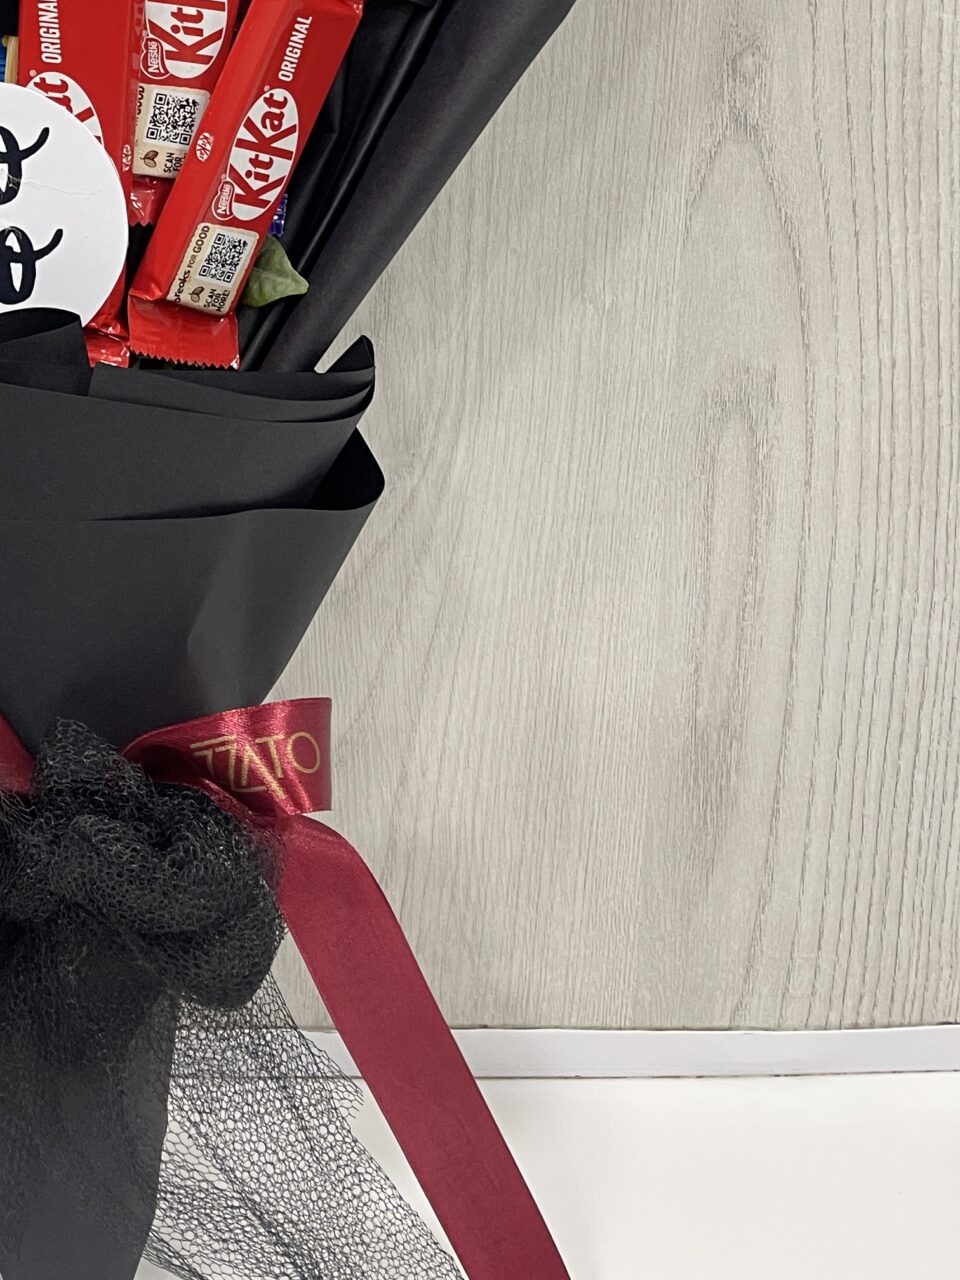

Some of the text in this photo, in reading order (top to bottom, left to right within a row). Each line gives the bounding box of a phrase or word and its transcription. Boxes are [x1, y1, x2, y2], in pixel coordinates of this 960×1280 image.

[278, 16, 313, 82] ORIGINAL
[163, 152, 175, 174] SCAN
[230, 92, 298, 210] KitKat
[192, 225, 210, 254] GOOD
[187, 254, 198, 268] FOR
